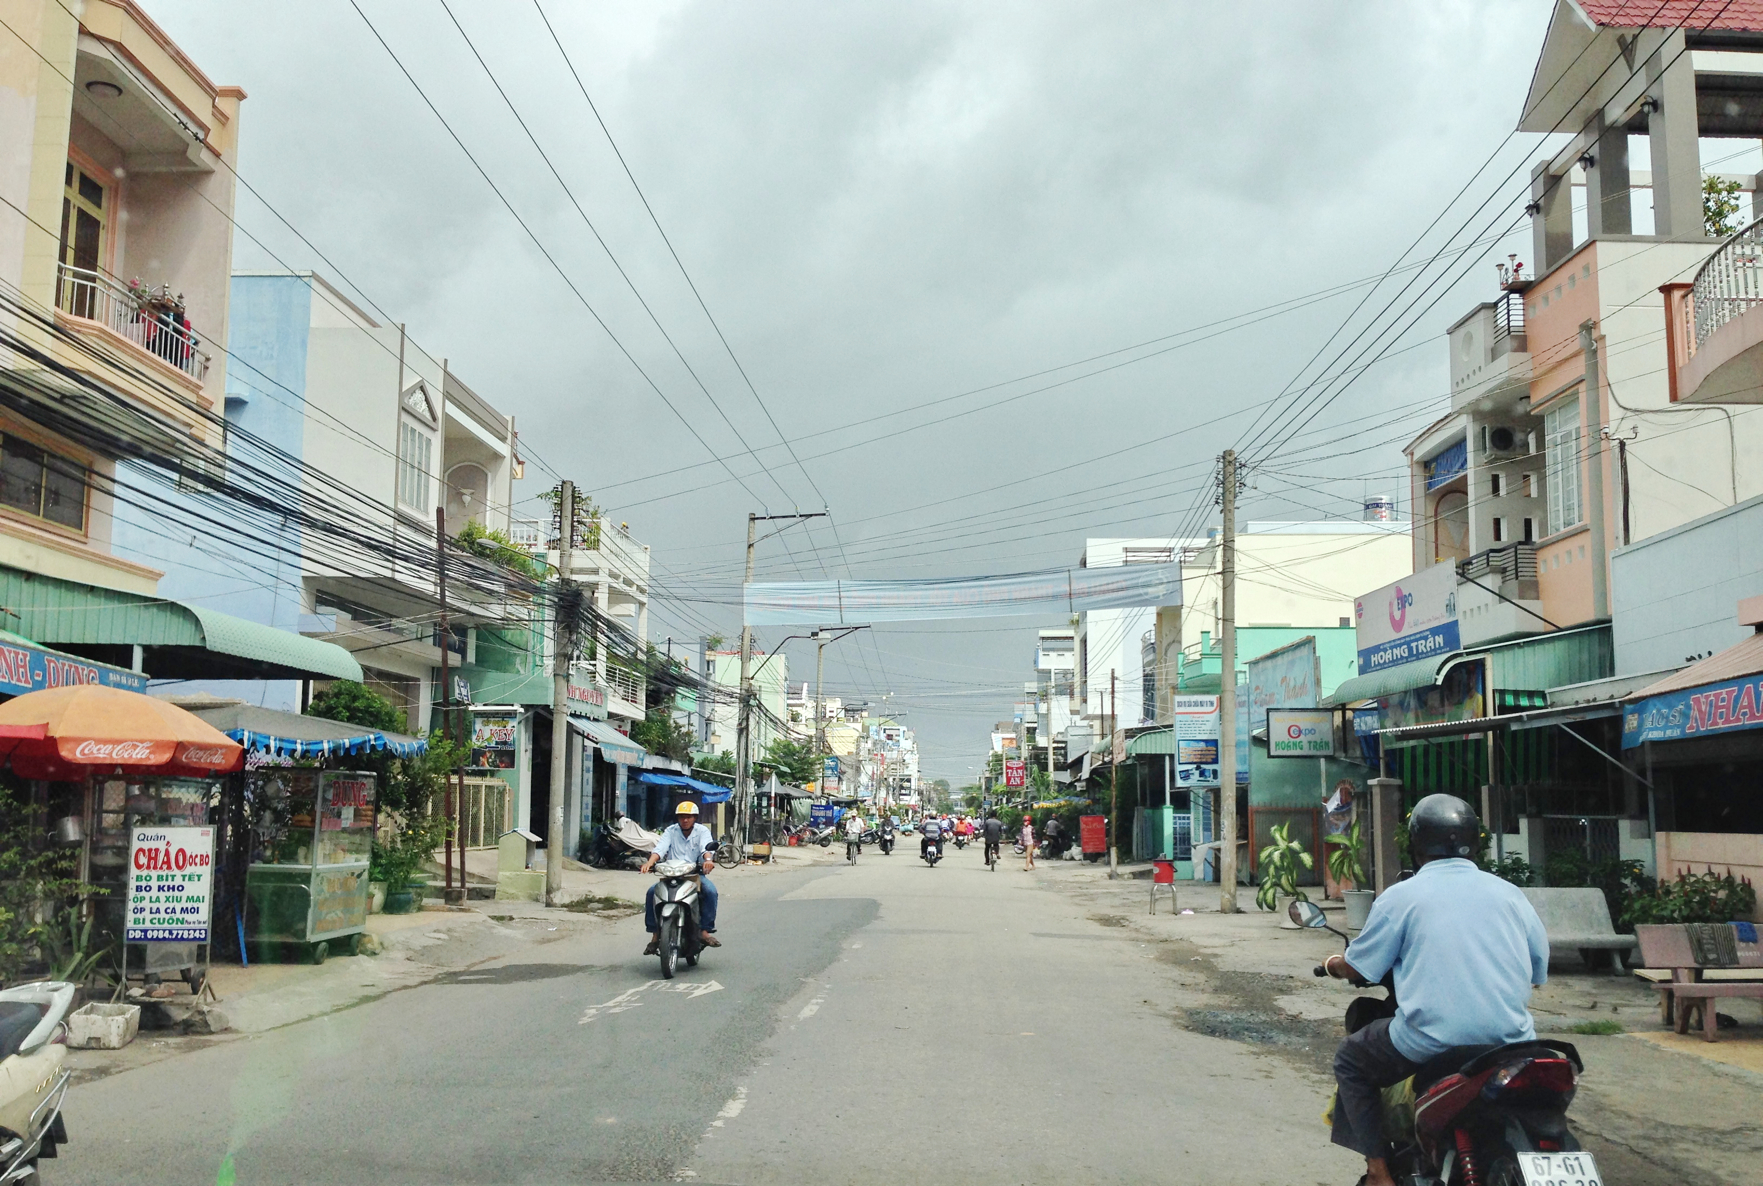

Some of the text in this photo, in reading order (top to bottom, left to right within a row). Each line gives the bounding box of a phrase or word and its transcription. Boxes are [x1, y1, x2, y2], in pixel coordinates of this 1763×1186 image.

[1293, 727, 1317, 737] expo
[137, 833, 166, 842] Quán
[157, 884, 185, 893] KHO
[147, 930, 206, 939] 0984.778243
